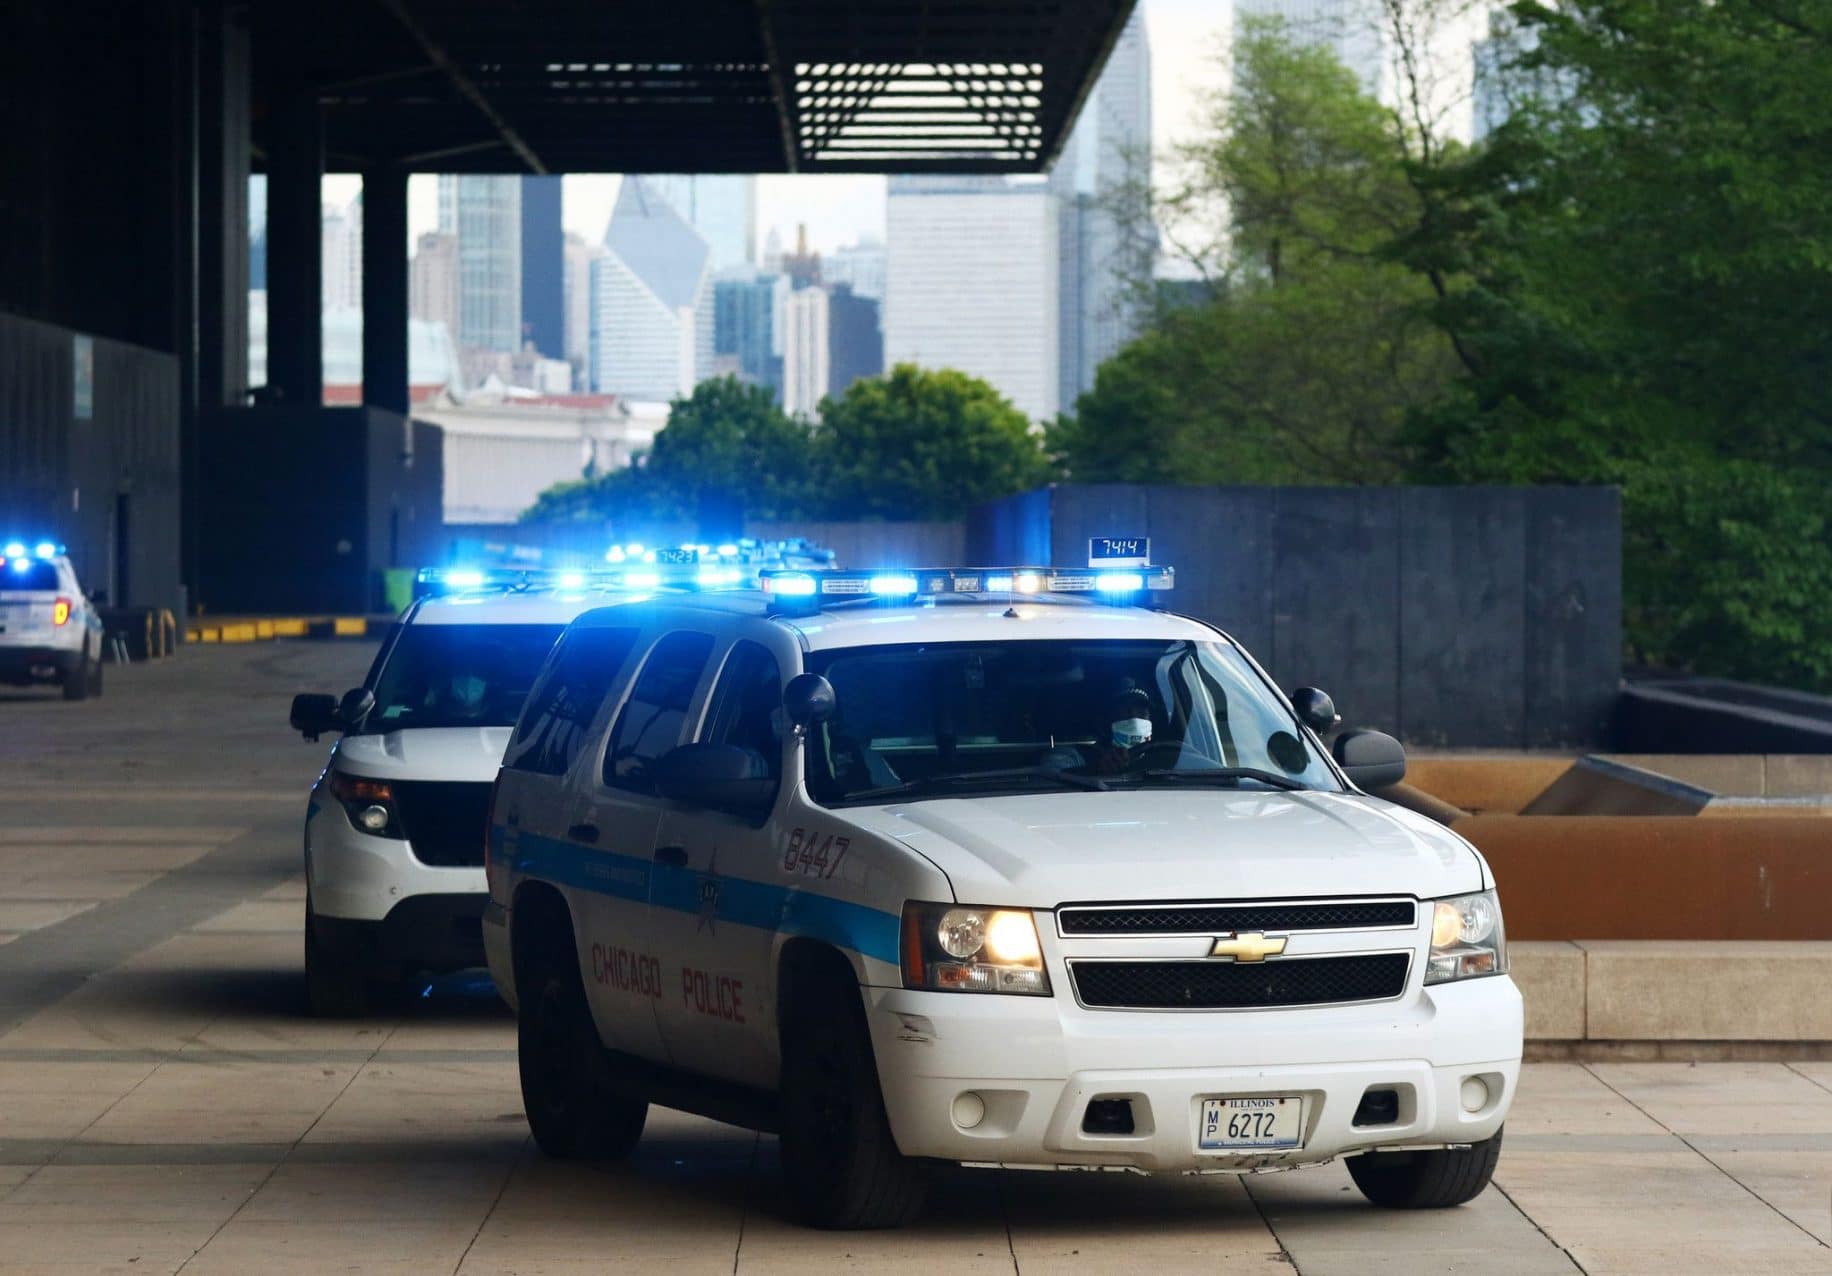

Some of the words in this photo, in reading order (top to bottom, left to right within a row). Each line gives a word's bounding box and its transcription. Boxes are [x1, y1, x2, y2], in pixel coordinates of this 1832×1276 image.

[1102, 539, 1138, 555] 7414
[784, 828, 850, 879] 8447
[592, 942, 662, 999] CHICAGO
[682, 967, 746, 1024] POLICE
[1230, 1099, 1275, 1108] ILLINOIS
[1228, 1112, 1276, 1138] 6272
